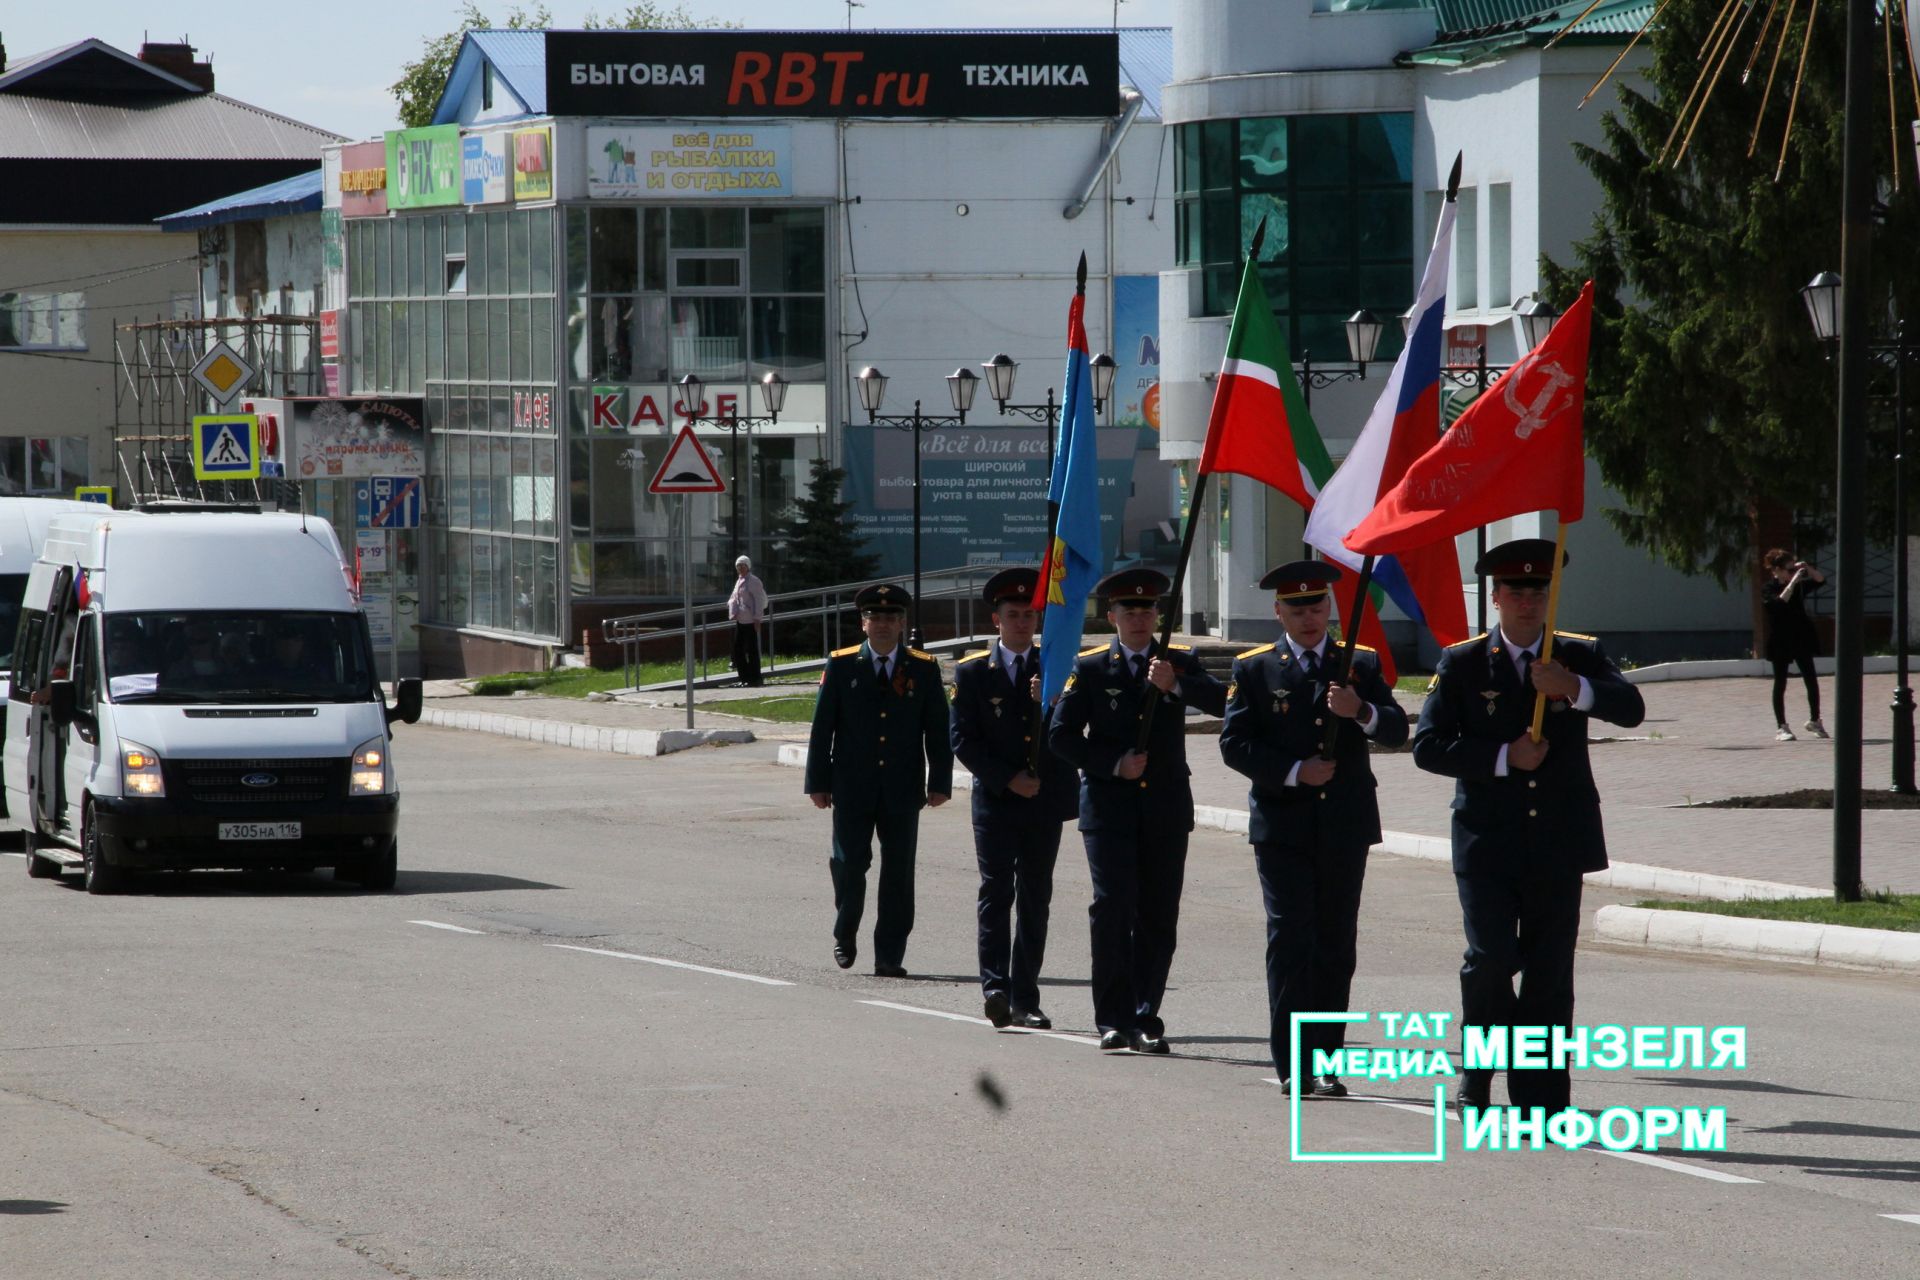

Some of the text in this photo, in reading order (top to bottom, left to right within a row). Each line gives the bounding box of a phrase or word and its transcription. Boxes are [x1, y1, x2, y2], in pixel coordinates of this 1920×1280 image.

[571, 63, 705, 85] БЫТОВАЯ
[727, 51, 930, 107] RBT.ru
[963, 64, 1089, 86] ТЕХНИКА
[673, 131, 753, 149] ВСЁ ДЛЯ
[651, 151, 776, 168] РЫБАЛКИ
[647, 172, 782, 191] И ОТДЫХА
[360, 401, 421, 430] САЛЮТЫ
[514, 392, 550, 429] КАФЕ
[974, 436, 1011, 453] для
[965, 460, 1027, 473] ШИРОКИЙ
[880, 477, 914, 487] выбо
[923, 479, 964, 488] товара
[966, 479, 990, 488] для
[992, 479, 1042, 487] личного
[932, 491, 962, 502] уюта
[965, 491, 973, 499] в
[976, 491, 1016, 499] вашем
[278, 823, 297, 834] 116
